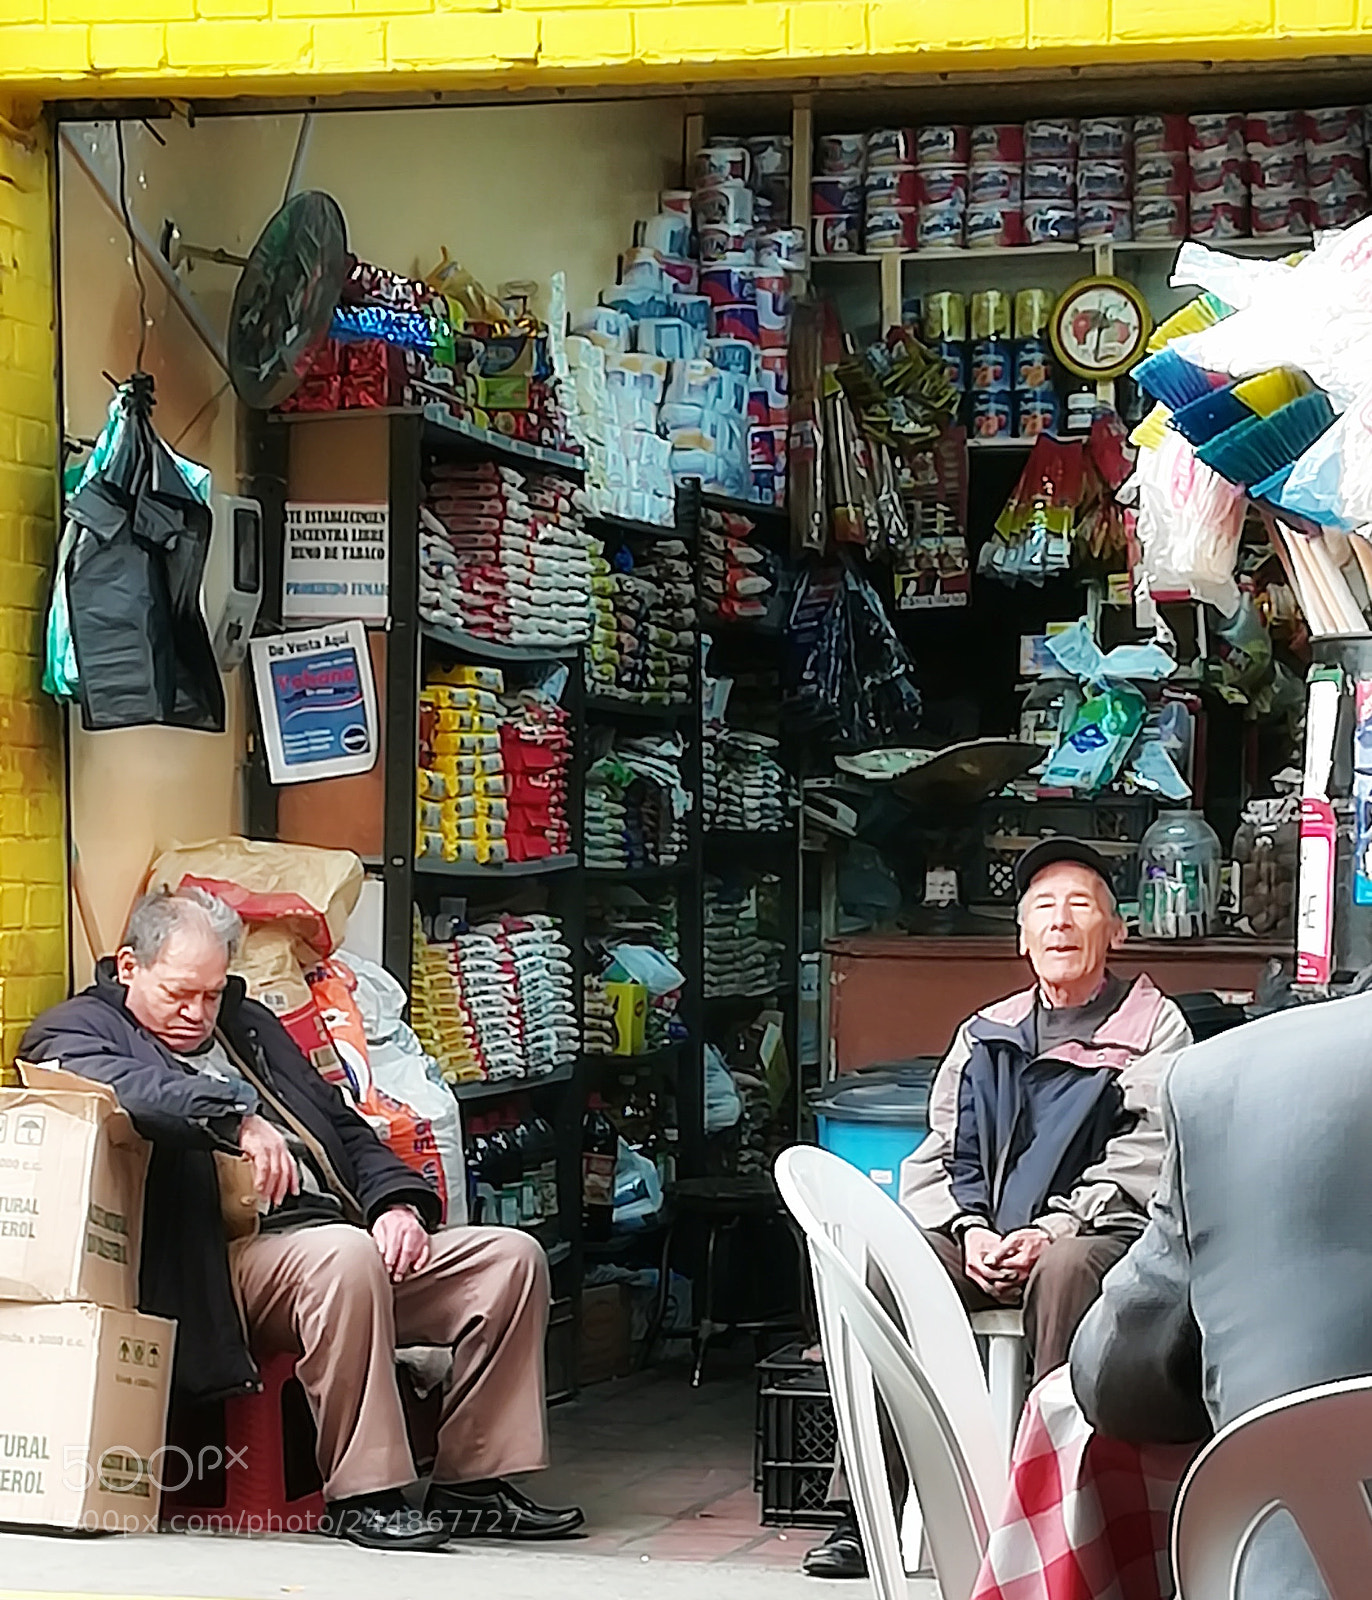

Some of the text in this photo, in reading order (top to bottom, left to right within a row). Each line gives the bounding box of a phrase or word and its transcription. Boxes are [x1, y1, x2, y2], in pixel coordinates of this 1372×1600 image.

[268, 644, 284, 657] De
[286, 638, 321, 653] Venta
[0, 1220, 35, 1239] EROL
[0, 1469, 45, 1494] EROL
